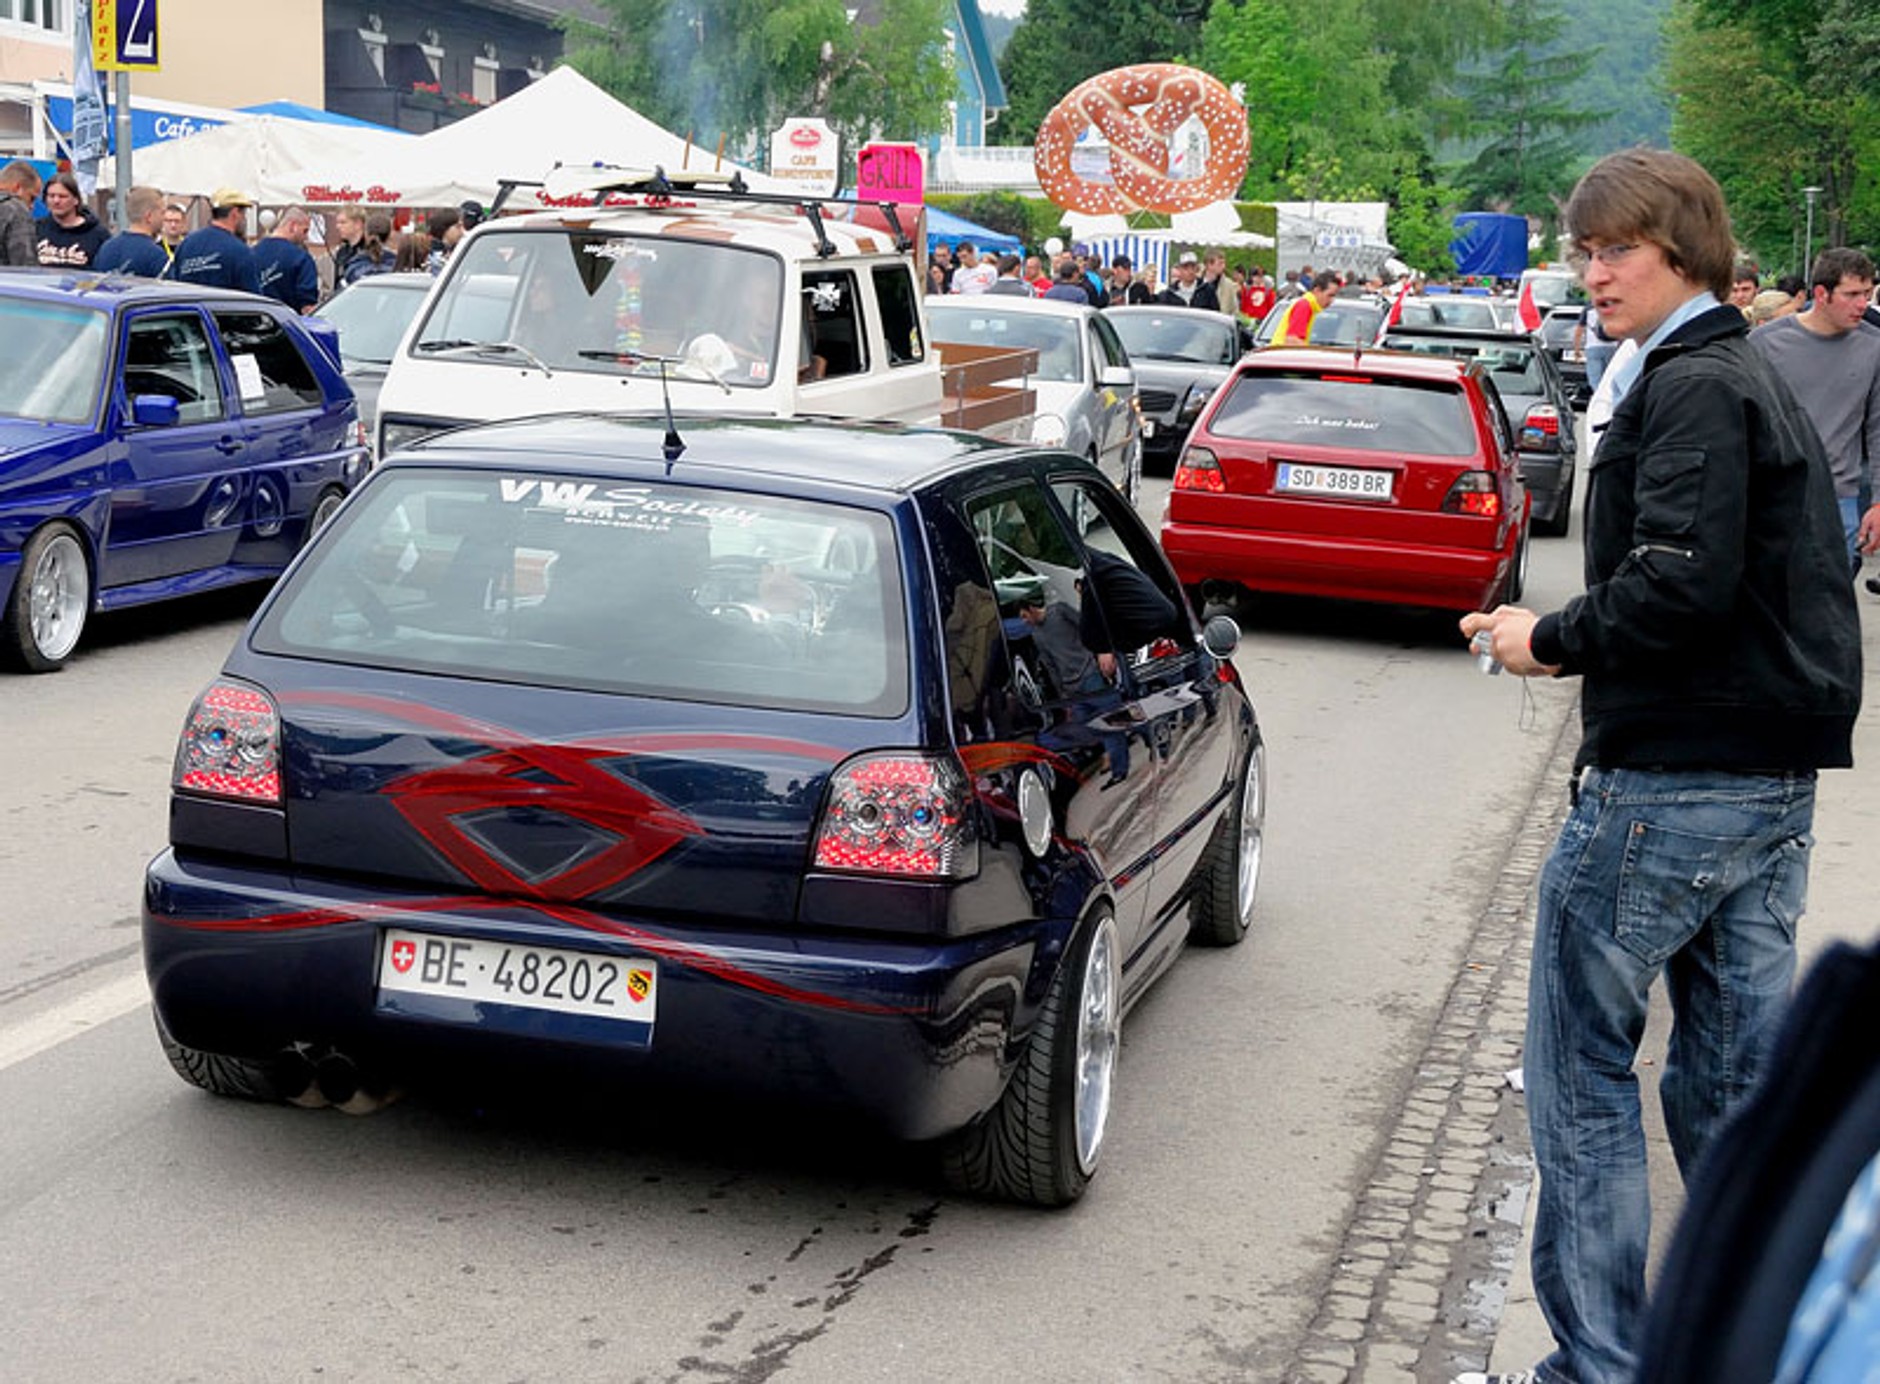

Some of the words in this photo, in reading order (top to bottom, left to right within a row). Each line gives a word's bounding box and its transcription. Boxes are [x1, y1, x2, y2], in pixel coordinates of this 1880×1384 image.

[860, 150, 913, 189] GRILL
[500, 478, 598, 508] VW
[1292, 469, 1315, 488] SD
[1326, 472, 1361, 491] 389
[1362, 474, 1387, 493] BR
